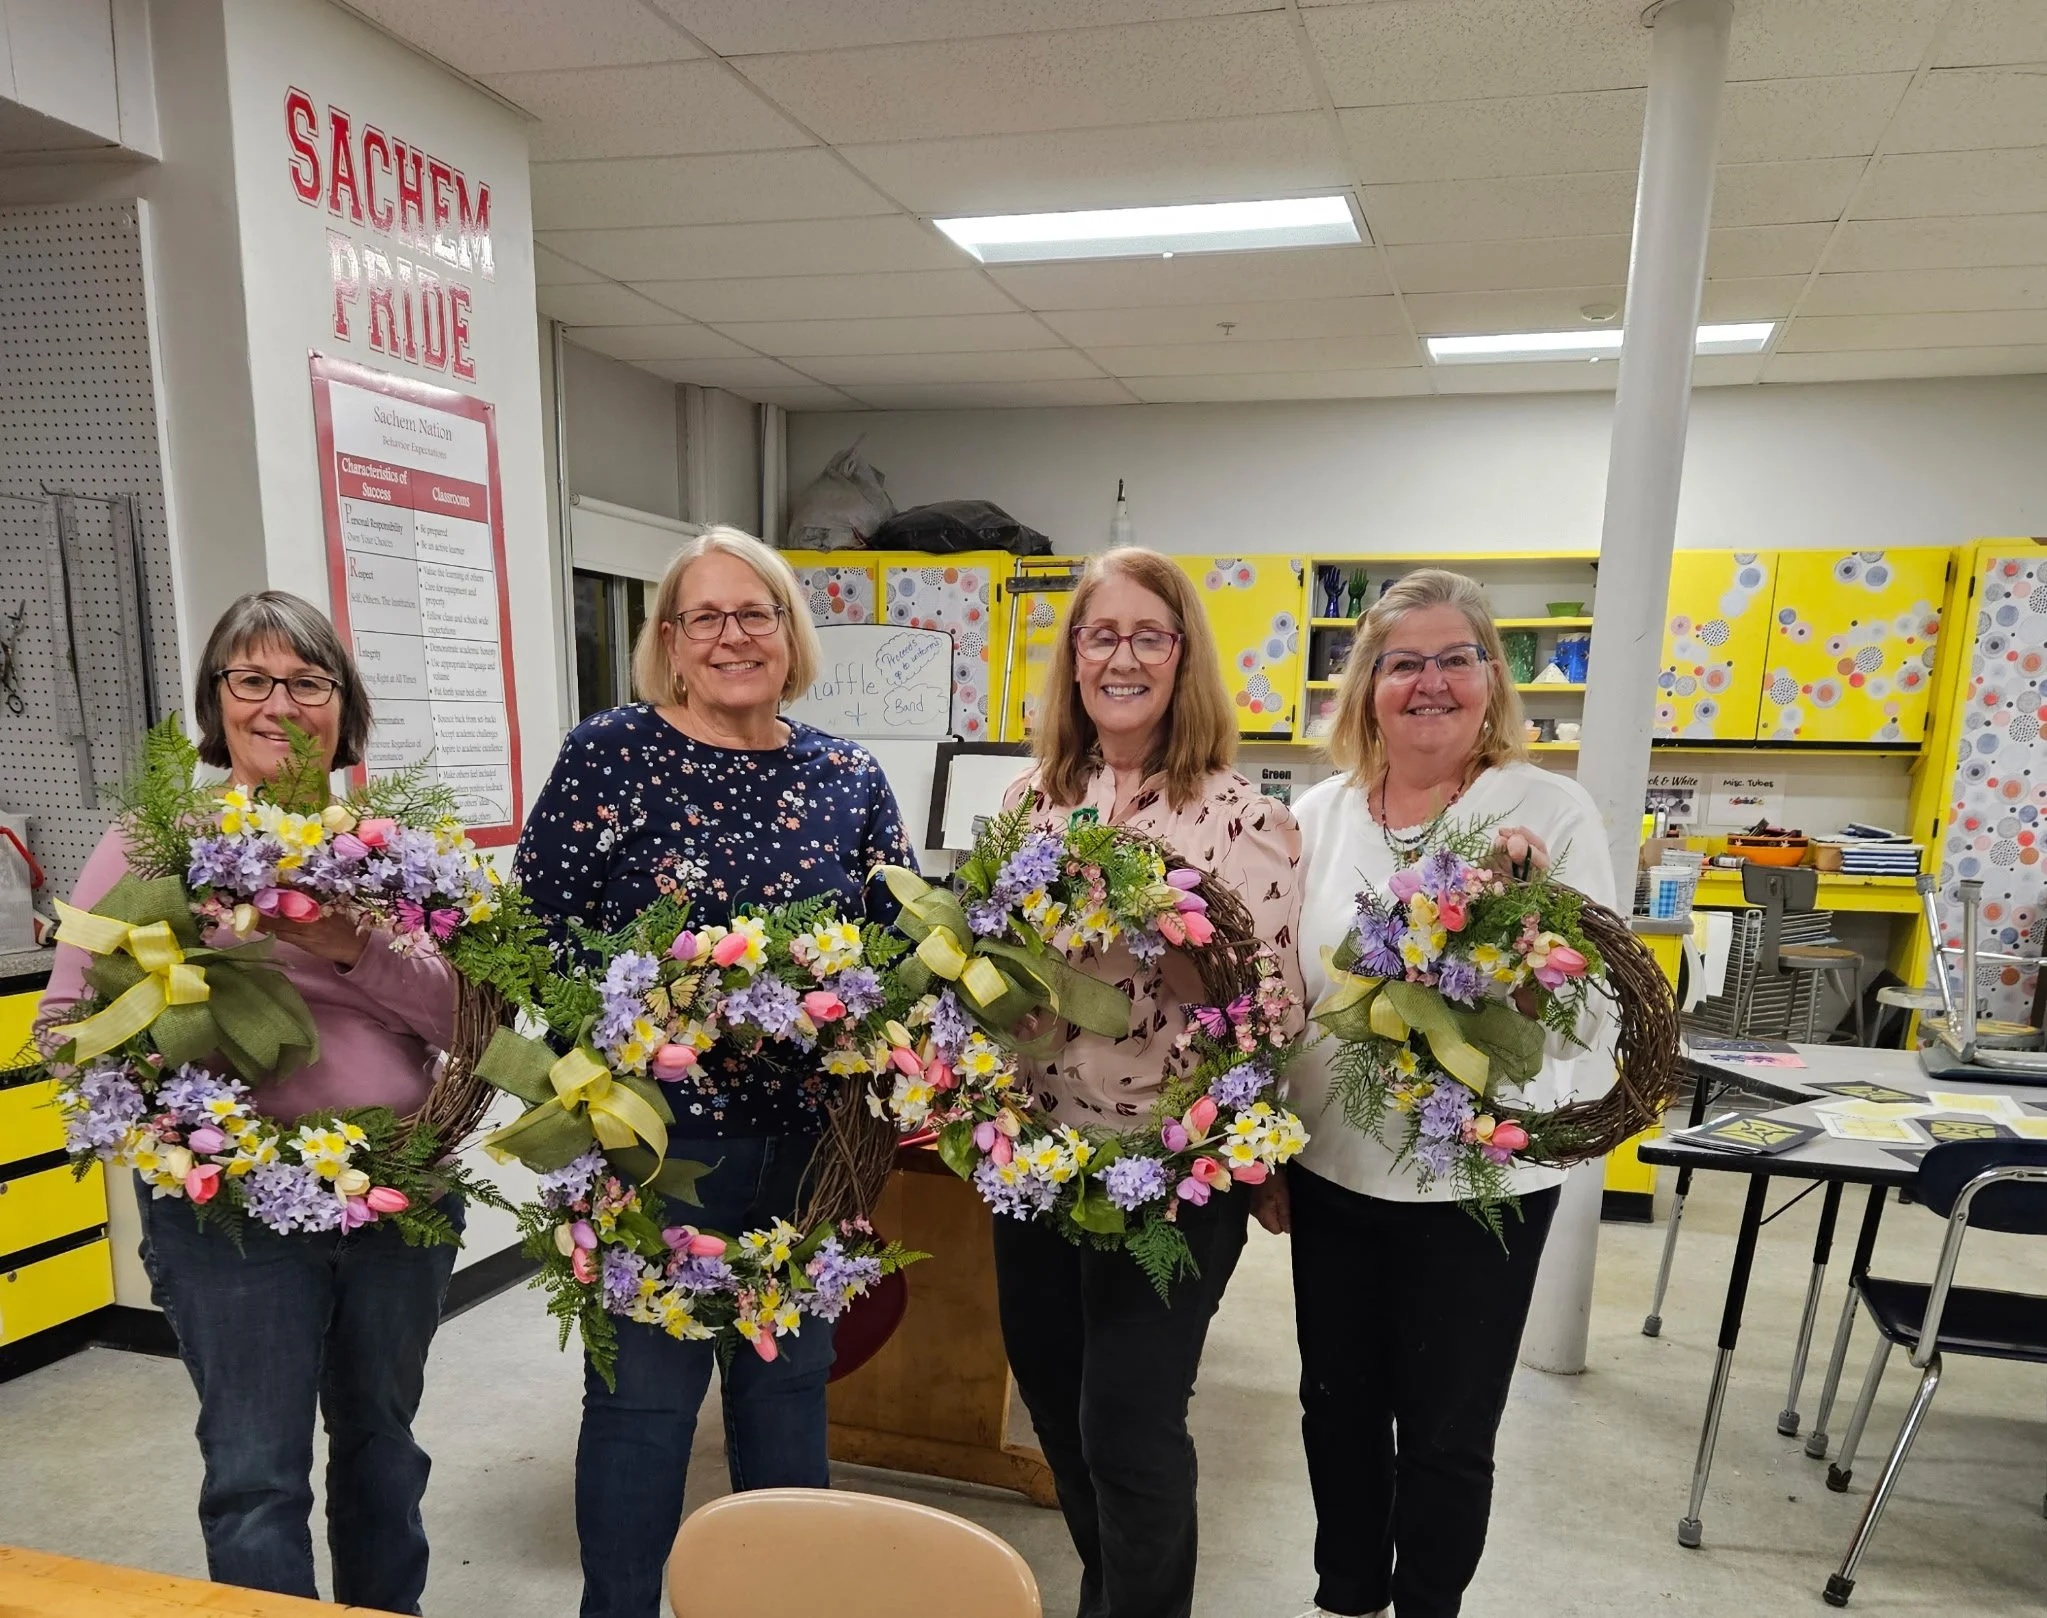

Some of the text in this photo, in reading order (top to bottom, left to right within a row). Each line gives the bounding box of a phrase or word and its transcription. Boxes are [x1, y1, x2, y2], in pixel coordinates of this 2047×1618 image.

[284, 85, 495, 284] SACHEM
[326, 227, 477, 384] PRIDE
[374, 405, 452, 442] Sachem Nation
[382, 435, 447, 460] Behavior Expectations
[341, 457, 408, 485] Characteristics of
[362, 482, 391, 501] Success
[432, 486, 470, 508] Classrooms
[344, 502, 403, 535] Personal Responsibility
[361, 534, 373, 545] Your
[427, 526, 448, 537] prepared
[349, 556, 374, 581] Respect
[895, 693, 924, 714] Band
[1262, 768, 1292, 780] Green
[1660, 776, 1670, 786] &
[1672, 775, 1698, 786] White
[1747, 780, 1774, 788] Tubes
